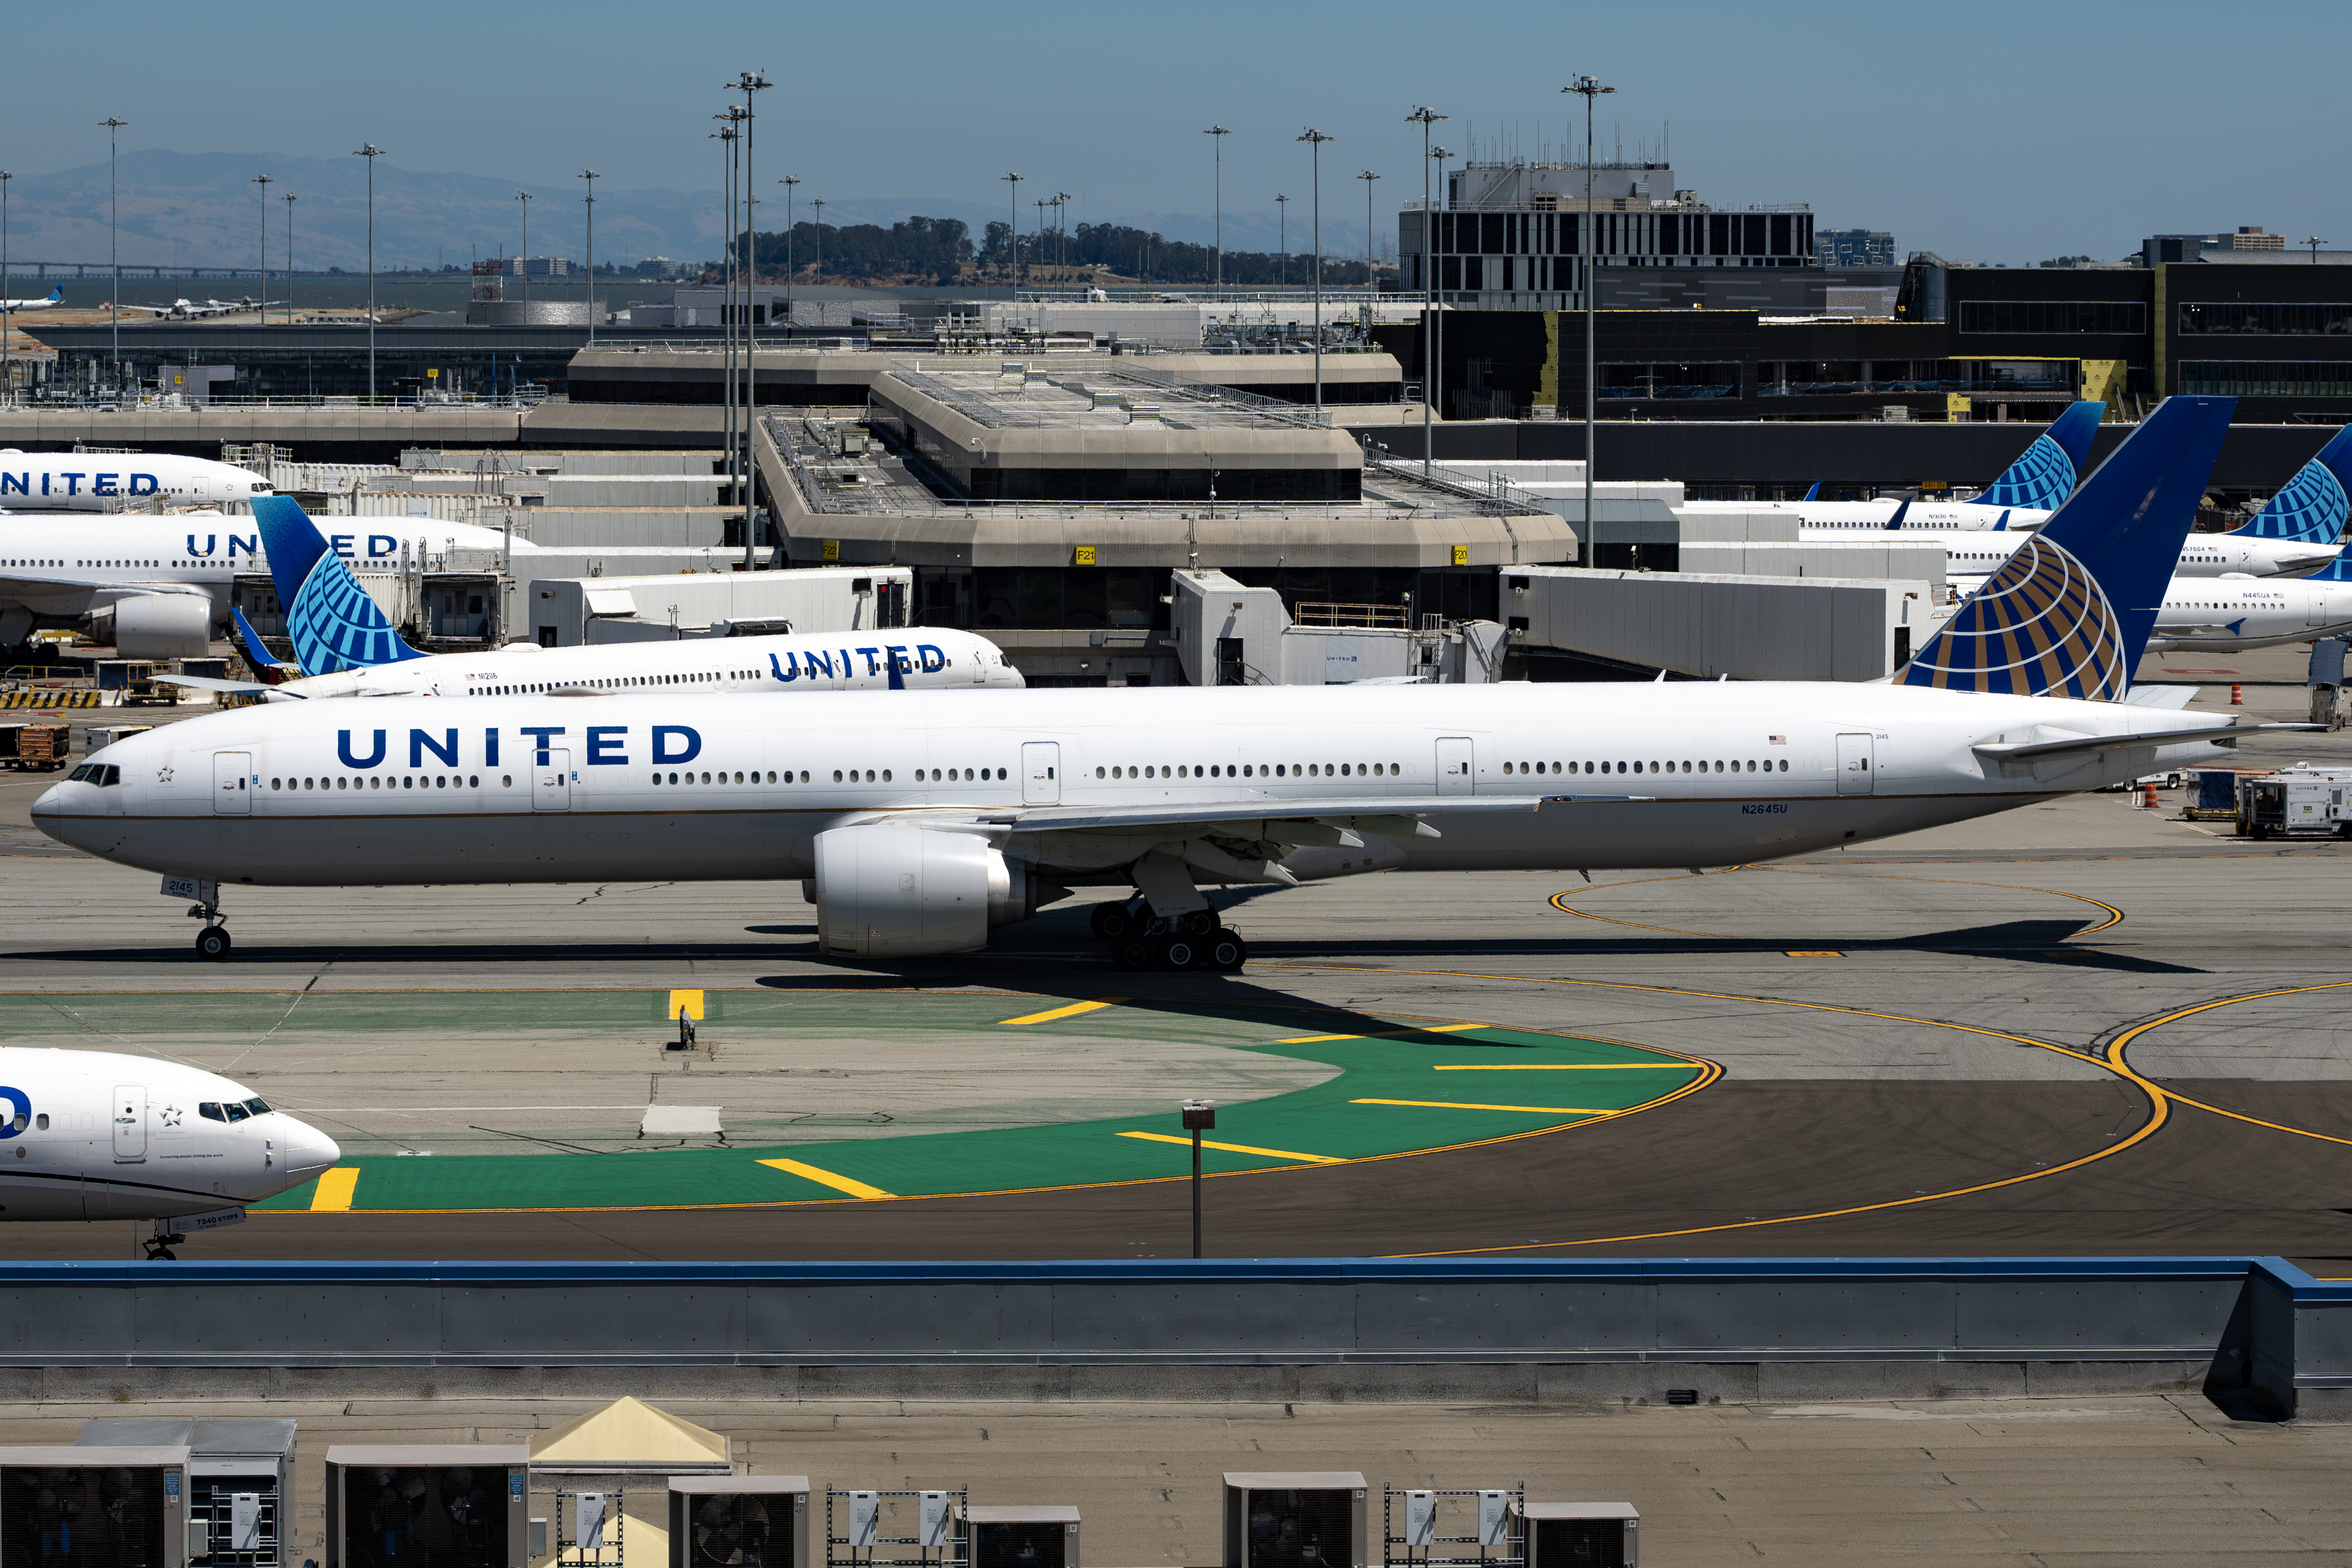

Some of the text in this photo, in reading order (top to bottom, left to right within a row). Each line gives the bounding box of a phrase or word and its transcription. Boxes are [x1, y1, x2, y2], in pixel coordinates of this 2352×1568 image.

[187, 534, 397, 557] UNED
[823, 545, 836, 555] F22
[1078, 550, 1094, 560] F21
[1455, 550, 1467, 559] F20
[768, 644, 945, 682] UNITED
[338, 725, 702, 769] UNITED
[1742, 804, 1788, 815] N2645U
[169, 881, 193, 893] 2145
[196, 1217, 217, 1226] 7340
[218, 1213, 239, 1222] ETOPS
